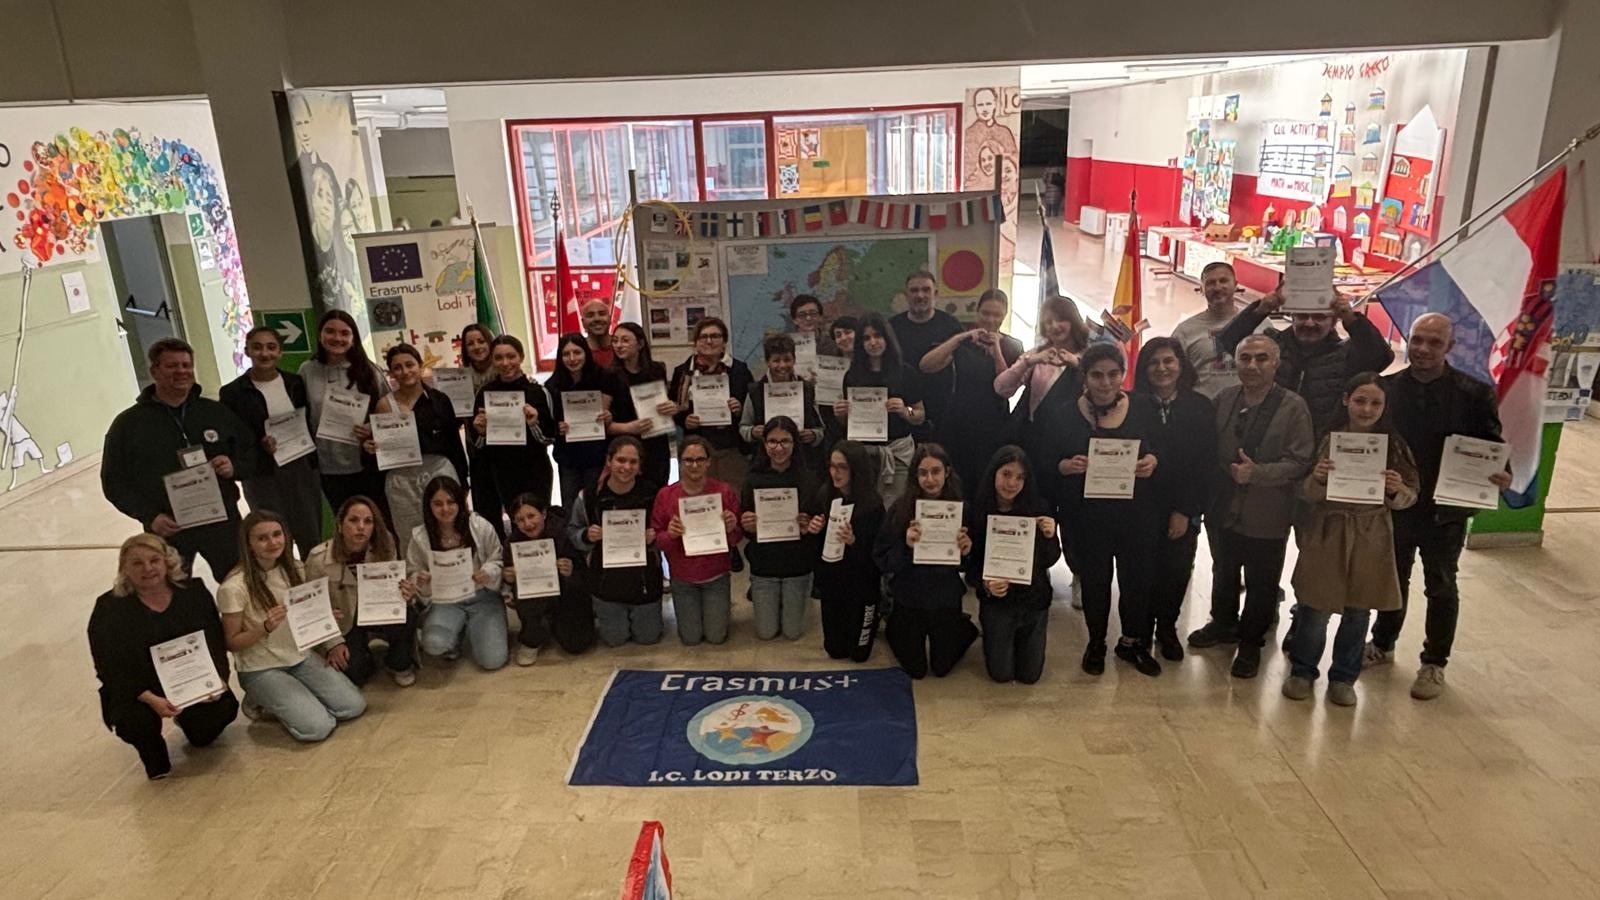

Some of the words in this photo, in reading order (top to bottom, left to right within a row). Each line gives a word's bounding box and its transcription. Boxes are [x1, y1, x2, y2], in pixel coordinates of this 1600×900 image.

[369, 282, 432, 297] Erasmus+
[437, 295, 462, 311] Lodi
[660, 673, 858, 692] Erasmus+
[693, 769, 751, 782] LODI
[756, 768, 837, 782] TERZO
